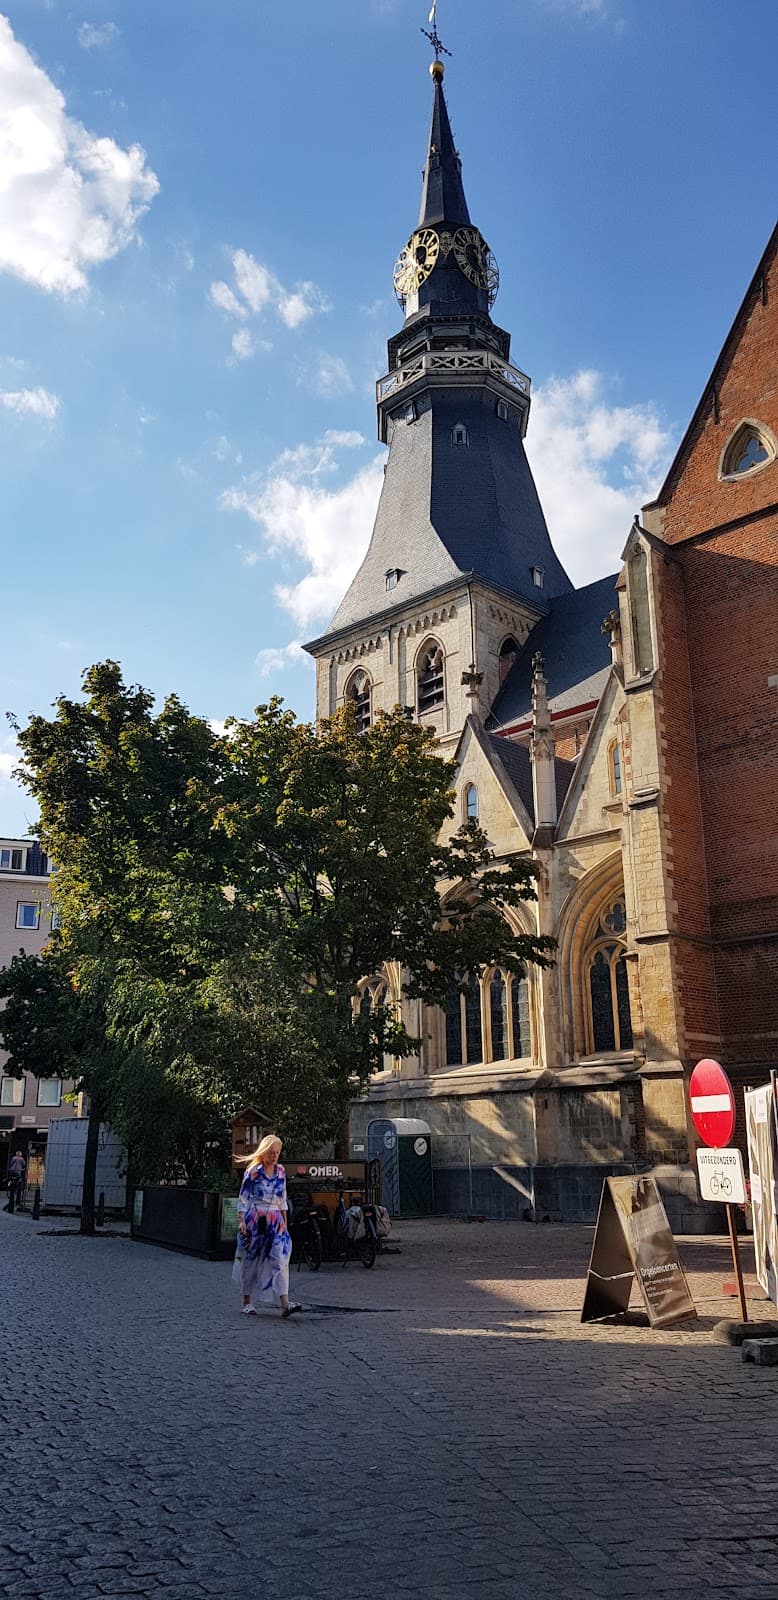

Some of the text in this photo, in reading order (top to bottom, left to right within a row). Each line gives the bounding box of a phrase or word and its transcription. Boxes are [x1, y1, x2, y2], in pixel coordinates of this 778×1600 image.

[699, 1155, 736, 1165] UITGEZONDERD
[309, 1166, 343, 1176] OMER.
[640, 1262, 677, 1278] Orgelconcerten
